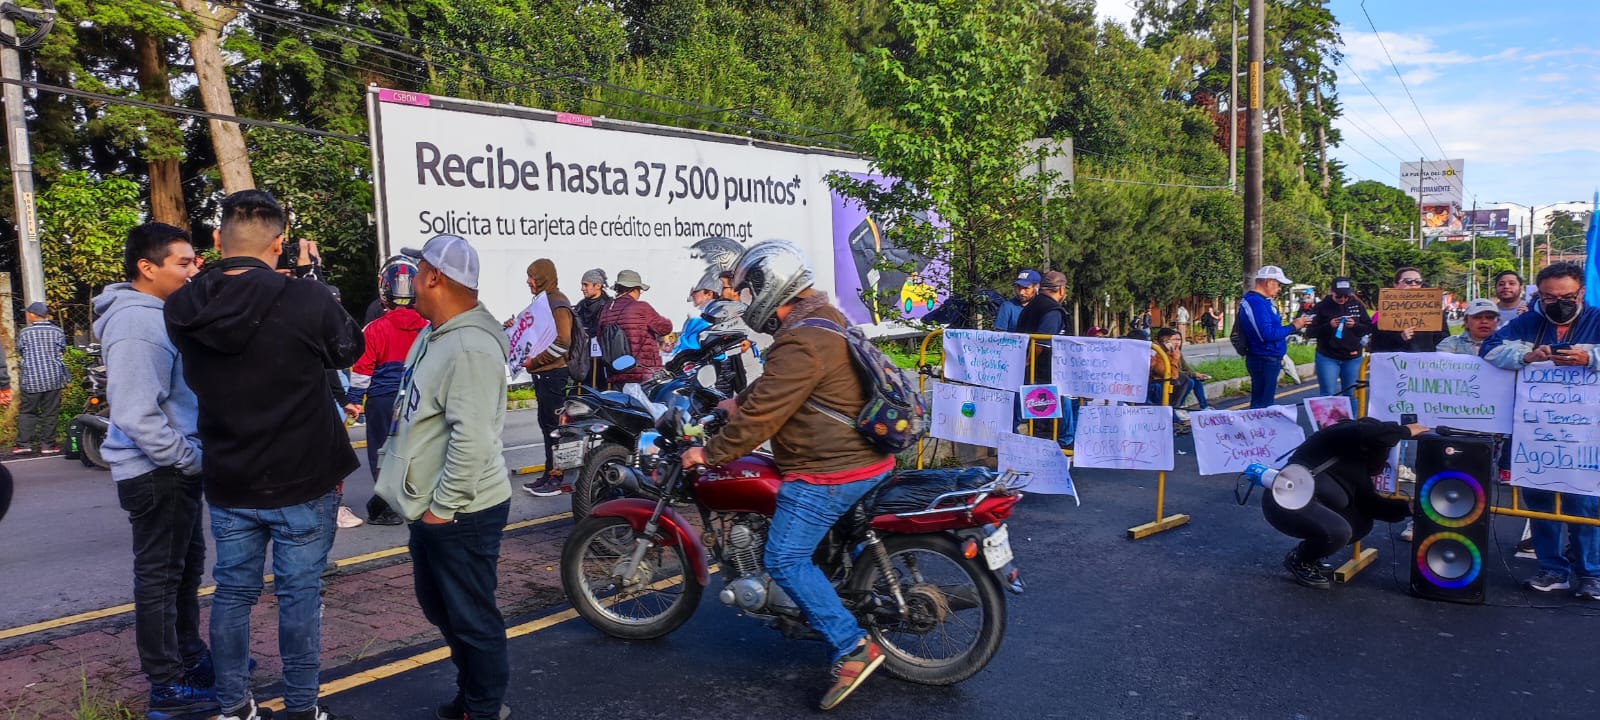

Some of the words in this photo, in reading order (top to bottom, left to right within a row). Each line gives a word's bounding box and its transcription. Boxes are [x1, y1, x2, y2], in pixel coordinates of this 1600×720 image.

[415, 141, 540, 191] Recibe
[545, 151, 629, 196] hasta
[634, 160, 719, 205] 37,500
[419, 209, 492, 235] Solicita
[496, 215, 515, 236] tu
[519, 212, 575, 242] tarjeta
[578, 214, 597, 236] de
[600, 214, 651, 237] crédito
[654, 221, 671, 237] en
[674, 216, 753, 243] bam.com.gt
[1407, 376, 1470, 397] ALIMENTA
